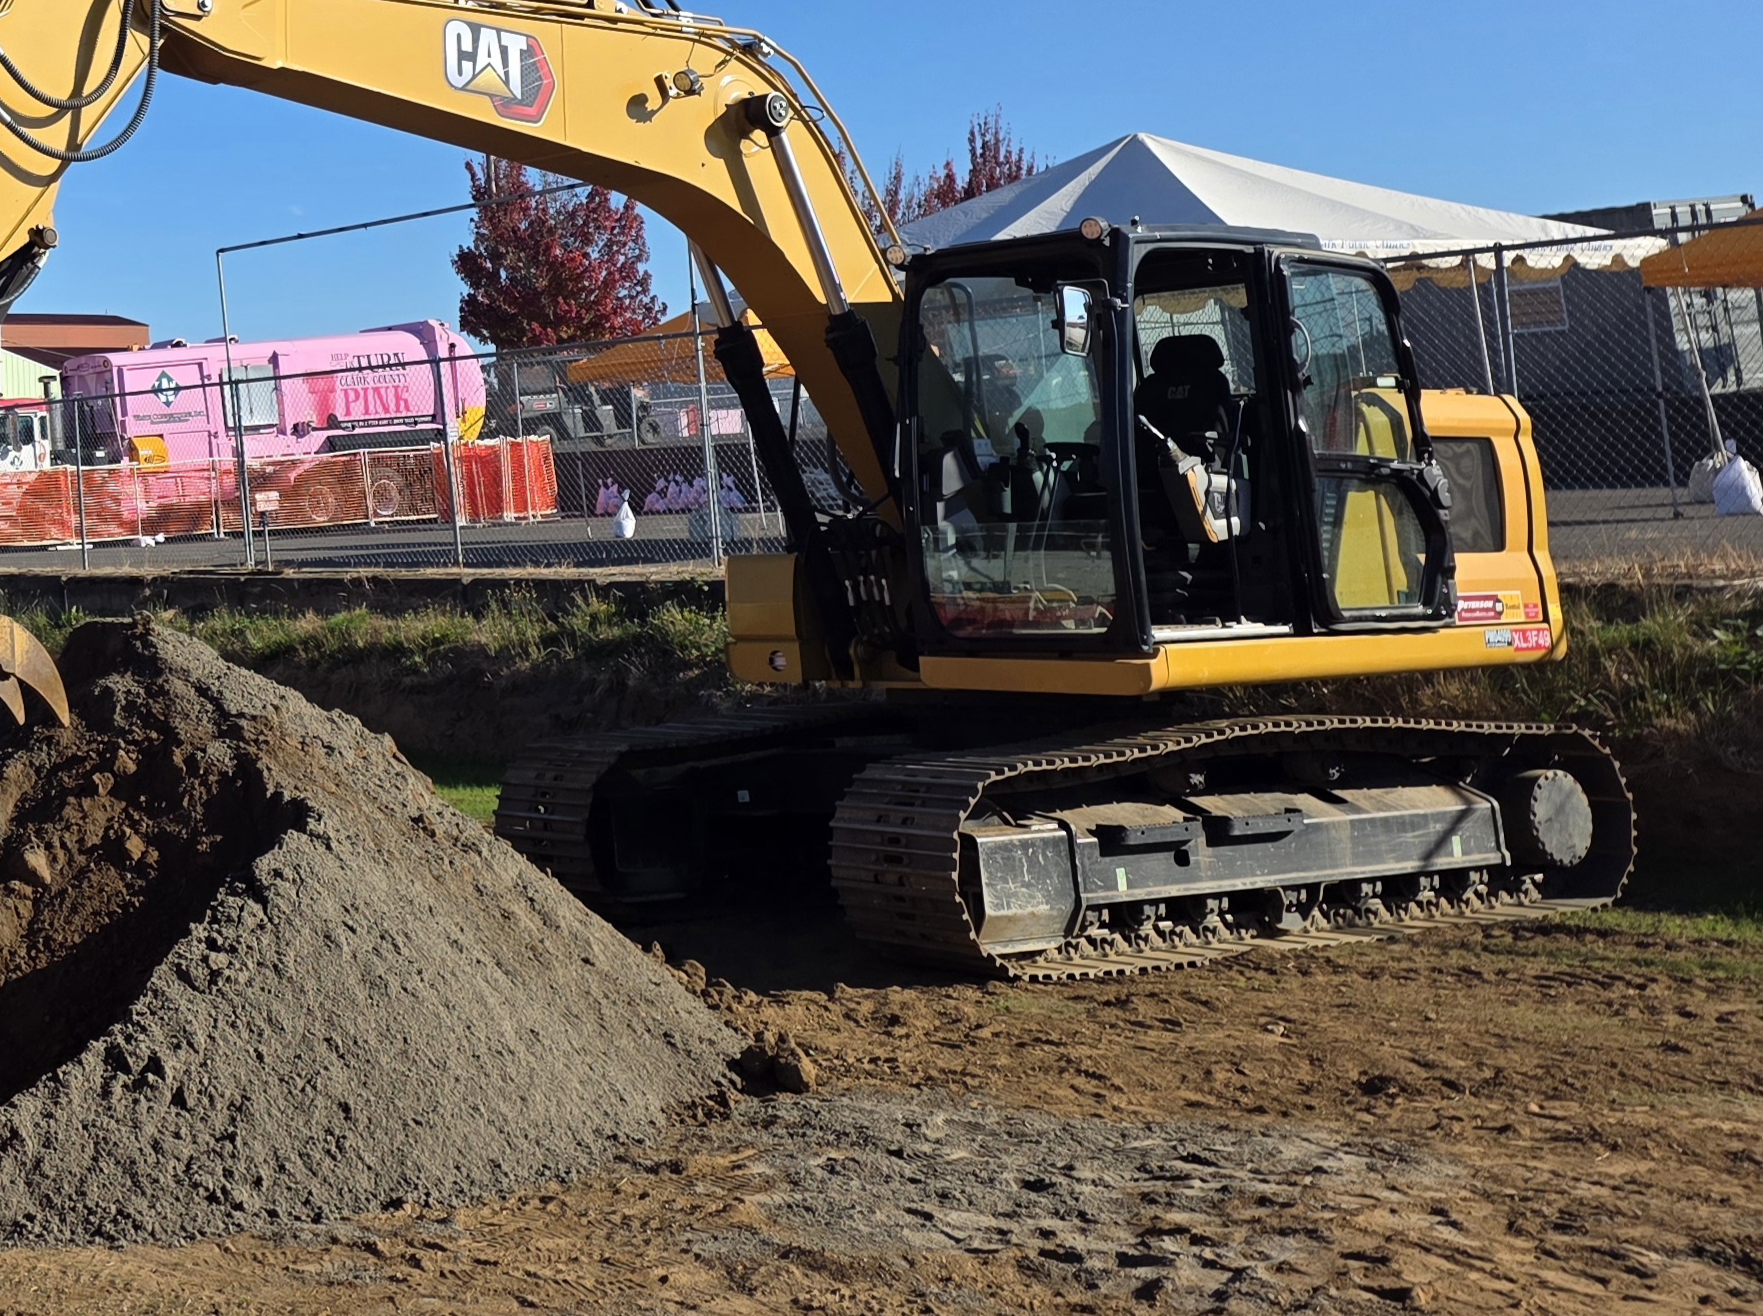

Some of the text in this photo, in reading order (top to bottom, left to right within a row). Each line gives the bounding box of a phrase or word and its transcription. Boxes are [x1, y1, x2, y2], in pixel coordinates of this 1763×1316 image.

[445, 19, 528, 100] CAT
[352, 352, 407, 372] TURN
[339, 373, 408, 387] CLARK COUNTY
[1167, 385, 1191, 399] CAT
[340, 385, 413, 417] PINK
[1457, 599, 1494, 613] PETERSON
